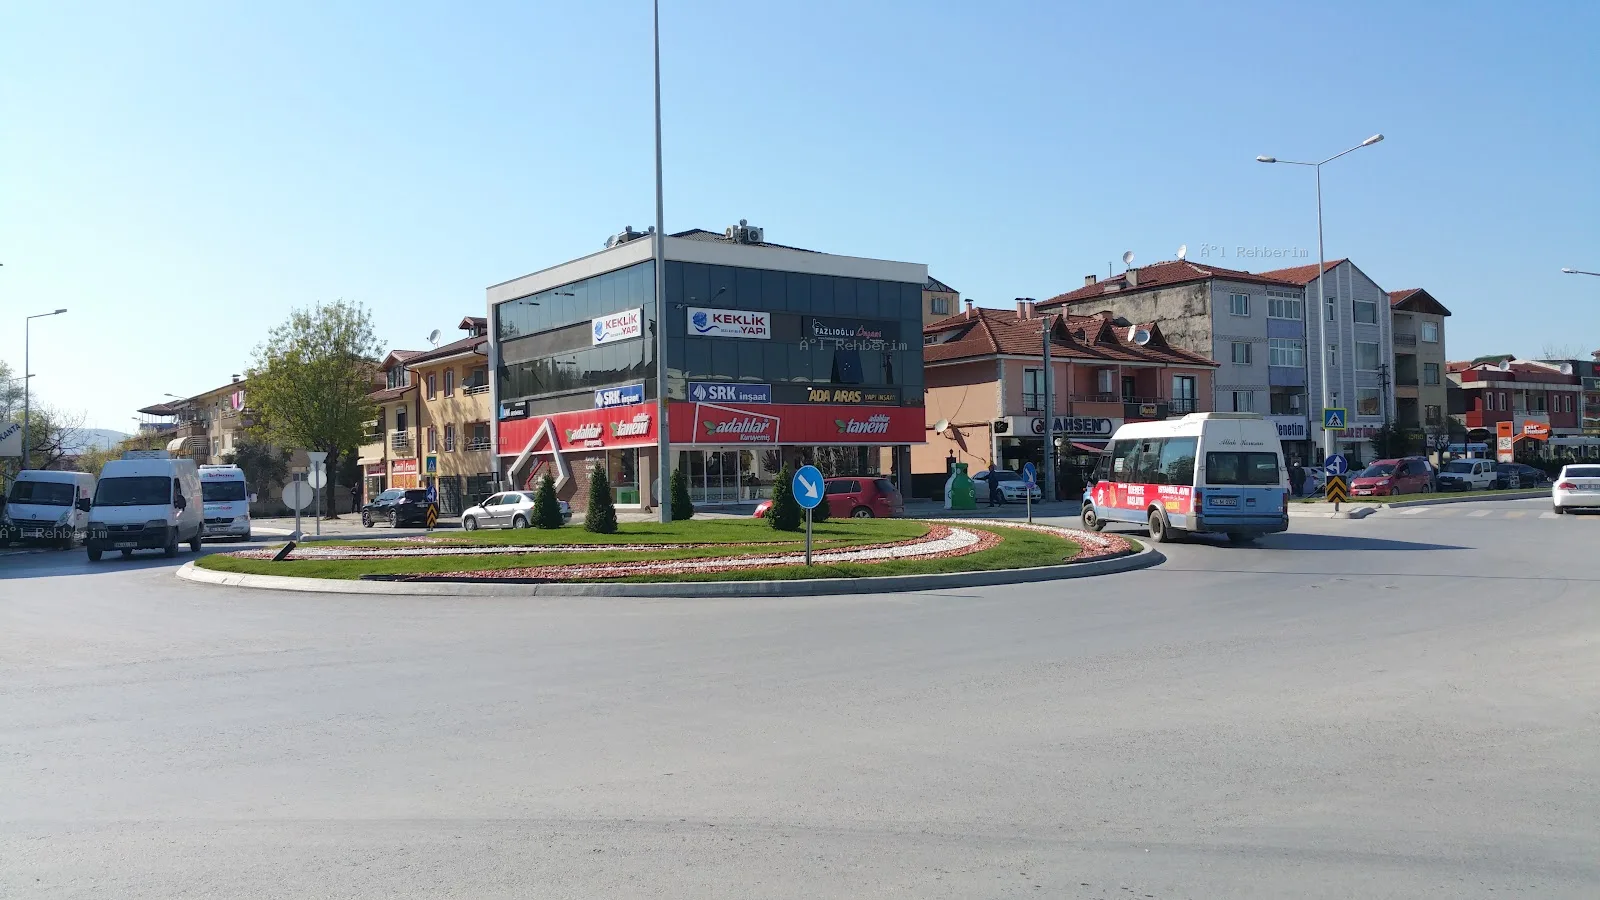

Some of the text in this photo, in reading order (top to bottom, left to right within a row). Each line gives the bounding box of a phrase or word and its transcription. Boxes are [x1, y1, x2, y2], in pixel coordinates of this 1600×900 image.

[605, 313, 637, 329] KEKLİK
[713, 314, 765, 326] KEKLİK
[622, 325, 638, 335] YAPI
[741, 327, 766, 335] YAPI
[603, 390, 621, 406] SRK
[708, 386, 767, 402] SRK inşaat
[808, 389, 831, 402] ADA
[833, 389, 862, 402] ARAS
[715, 417, 770, 433] adalılar
[846, 418, 889, 433] tanem
